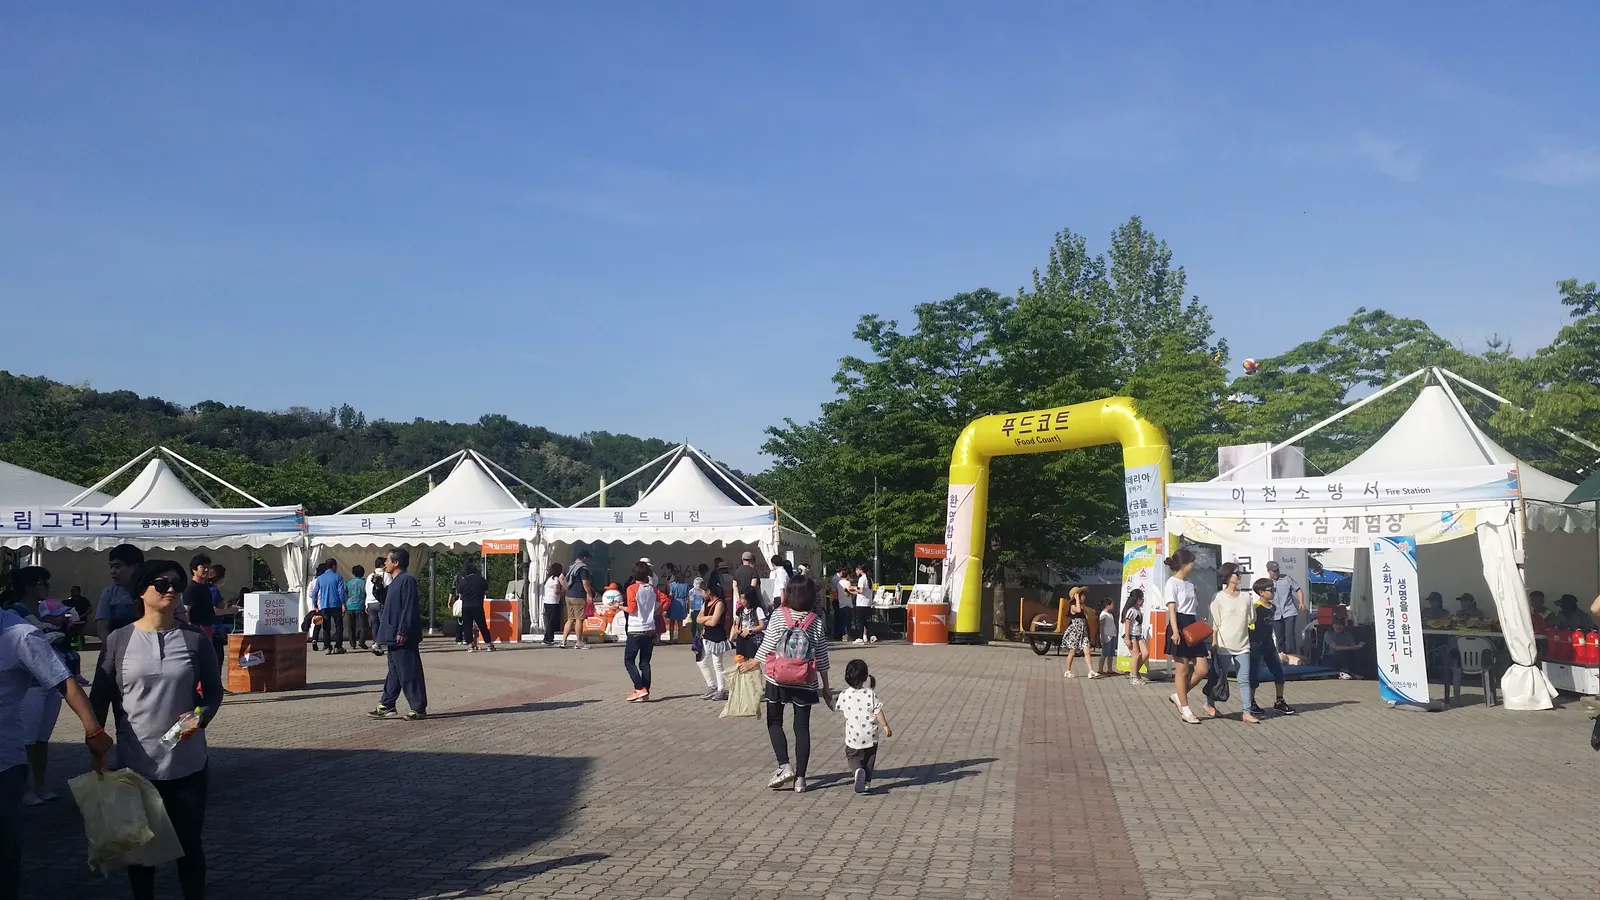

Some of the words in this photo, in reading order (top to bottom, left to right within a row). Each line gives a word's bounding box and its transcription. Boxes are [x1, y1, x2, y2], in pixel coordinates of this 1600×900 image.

[1002, 411, 1069, 437] 푸드코트
[1014, 436, 1036, 447] (Food
[1036, 434, 1062, 444] Court)
[1231, 480, 1380, 504] 이천소방서
[1385, 487, 1401, 496] Fire
[1402, 486, 1431, 496] Station
[0, 510, 118, 531] 림그리기
[361, 515, 447, 530] 라쿠소성
[613, 510, 700, 523] 월드비전
[264, 599, 285, 608] 당신은
[264, 608, 285, 617] 우리의
[264, 617, 299, 627] 희망입니다
